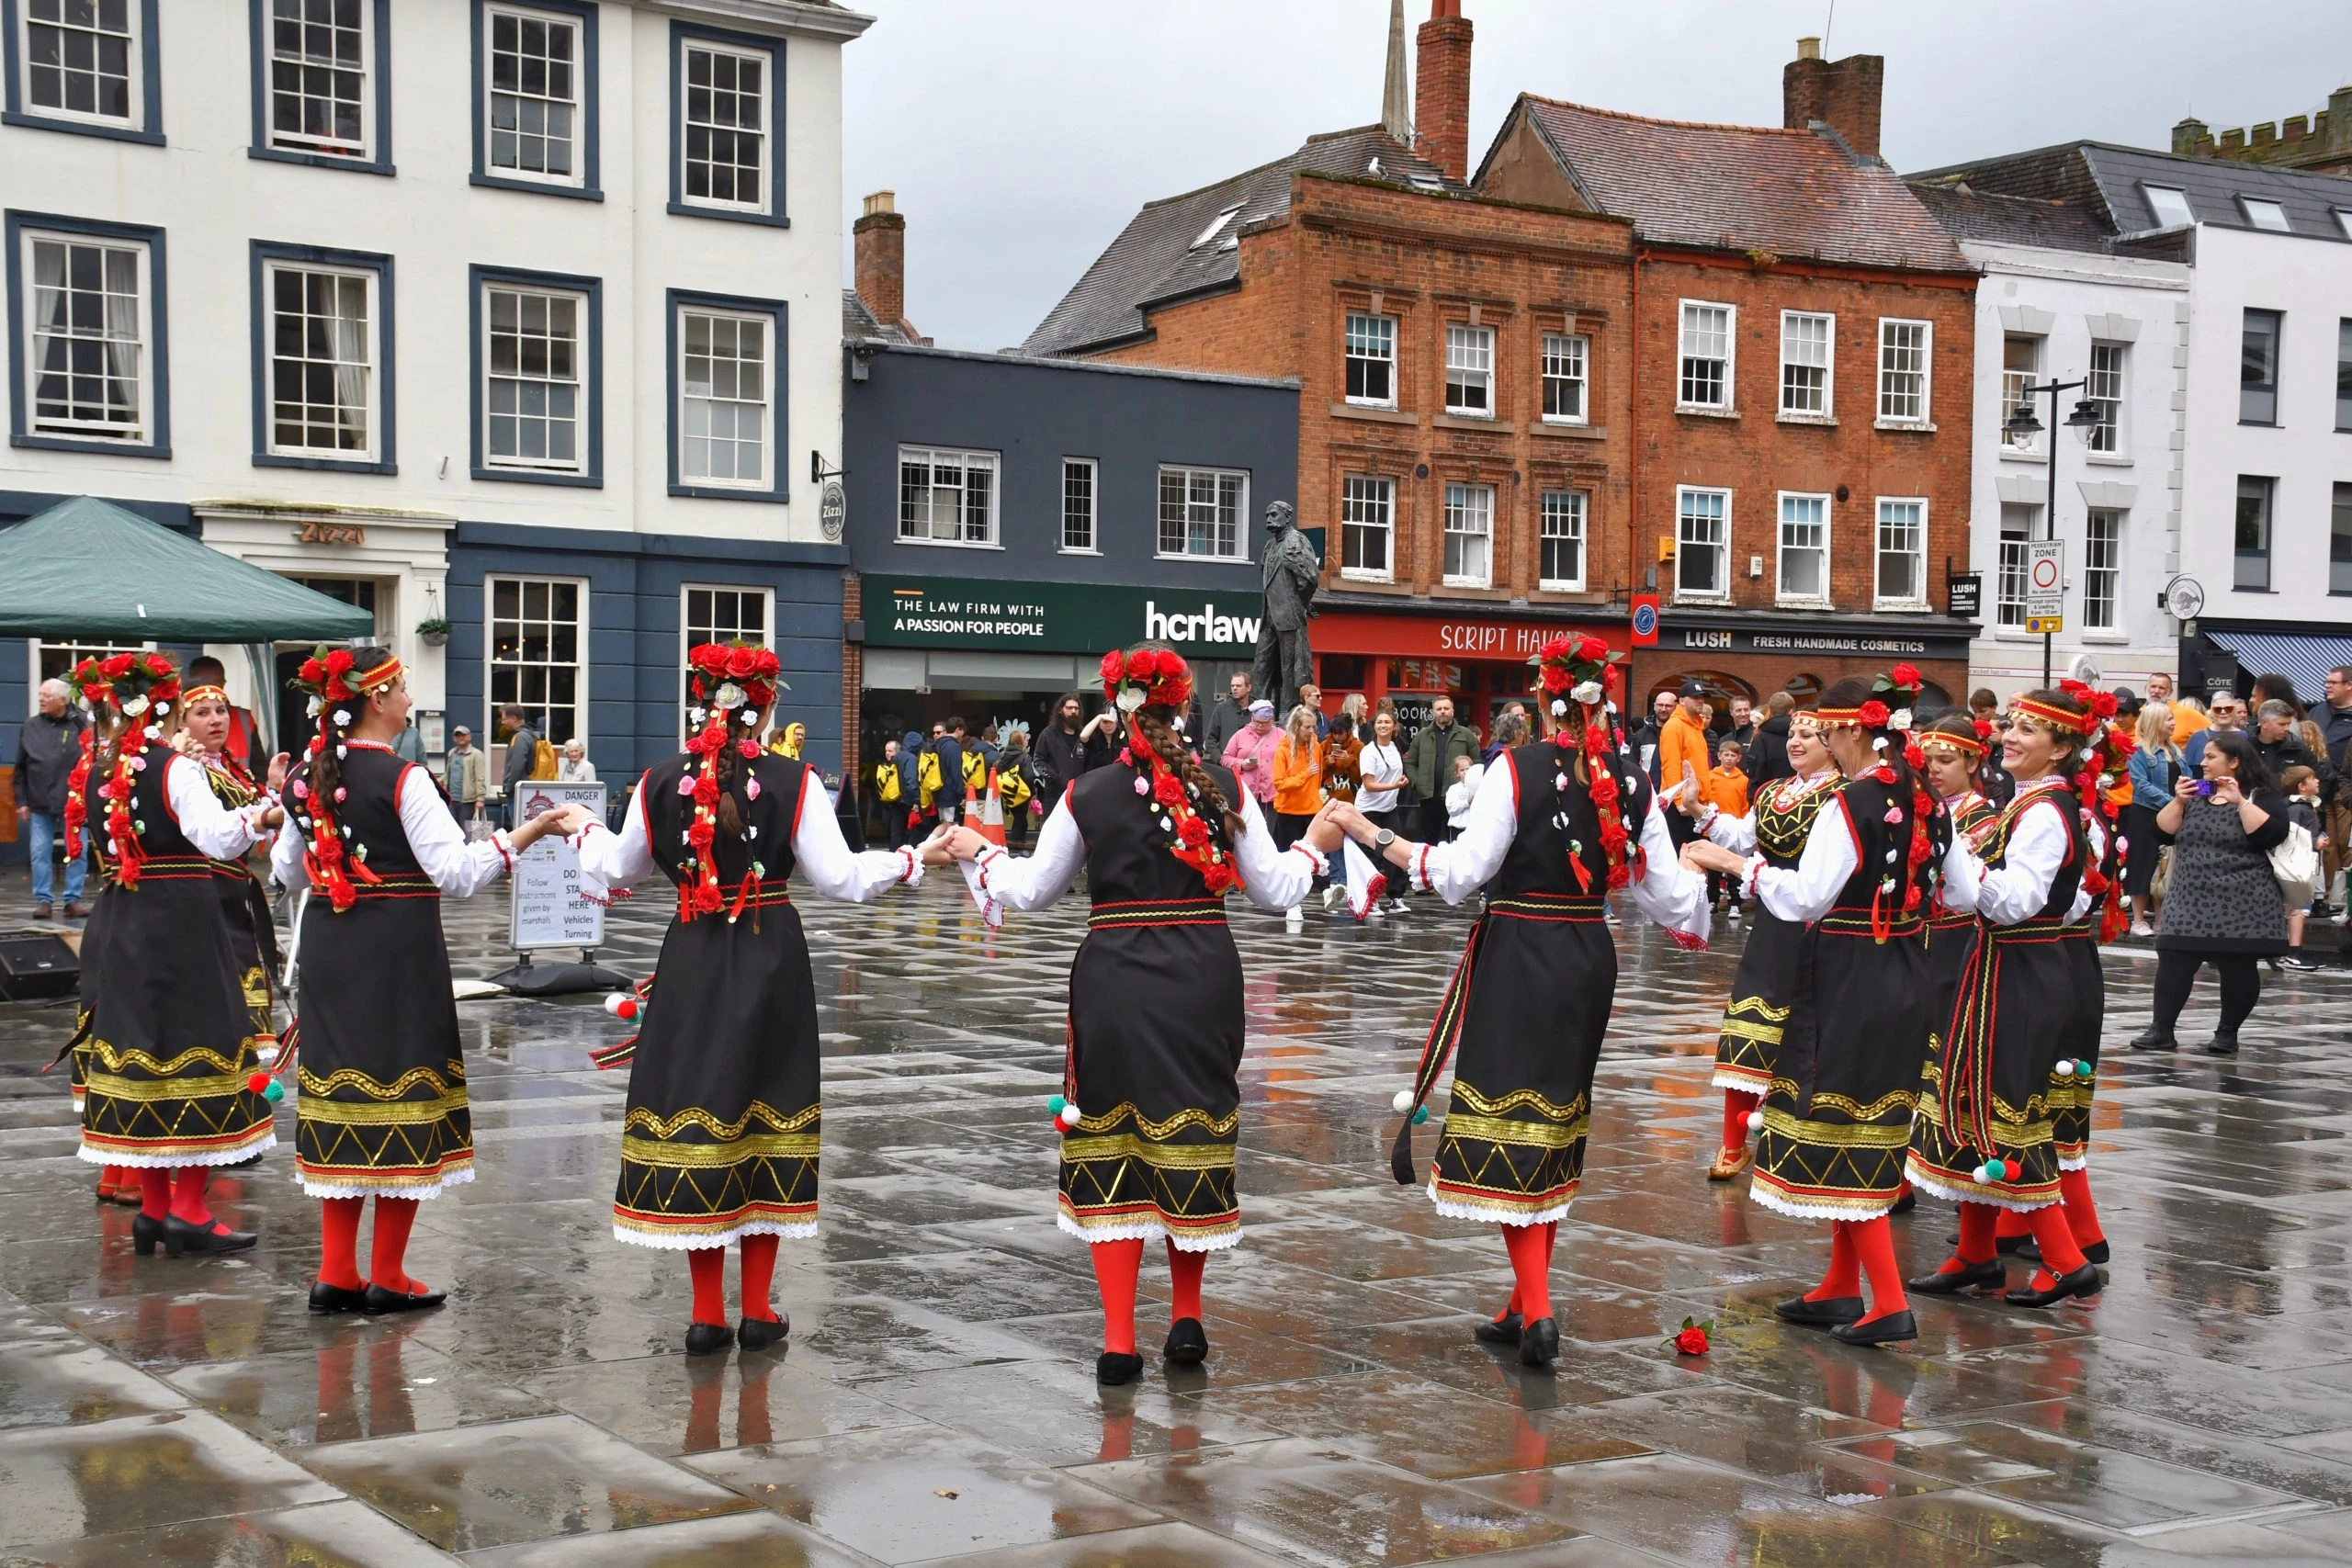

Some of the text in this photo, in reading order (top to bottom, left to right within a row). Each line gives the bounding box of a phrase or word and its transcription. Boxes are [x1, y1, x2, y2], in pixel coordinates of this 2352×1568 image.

[823, 504, 842, 519] Zizzi
[1952, 584, 1976, 593] LUSH
[895, 600, 1044, 616] THE LAW FIRM WITH
[894, 617, 1044, 636] A PASSION FOR PEOPLE
[1146, 601, 1261, 643] hcrlaw
[1441, 625, 1573, 653] SCRIPT HAV
[1685, 631, 1925, 652] LUSH FRESH HANDMADE COSMETICS
[2207, 677, 2233, 686] CÔTE
[565, 791, 599, 801] DANGER
[563, 869, 577, 879] DO
[526, 879, 548, 887] Follow
[523, 904, 551, 914] given by
[569, 900, 590, 909] HERE
[521, 916, 551, 925] marshals
[563, 915, 594, 924] Vehicles
[564, 929, 593, 939] Turning
